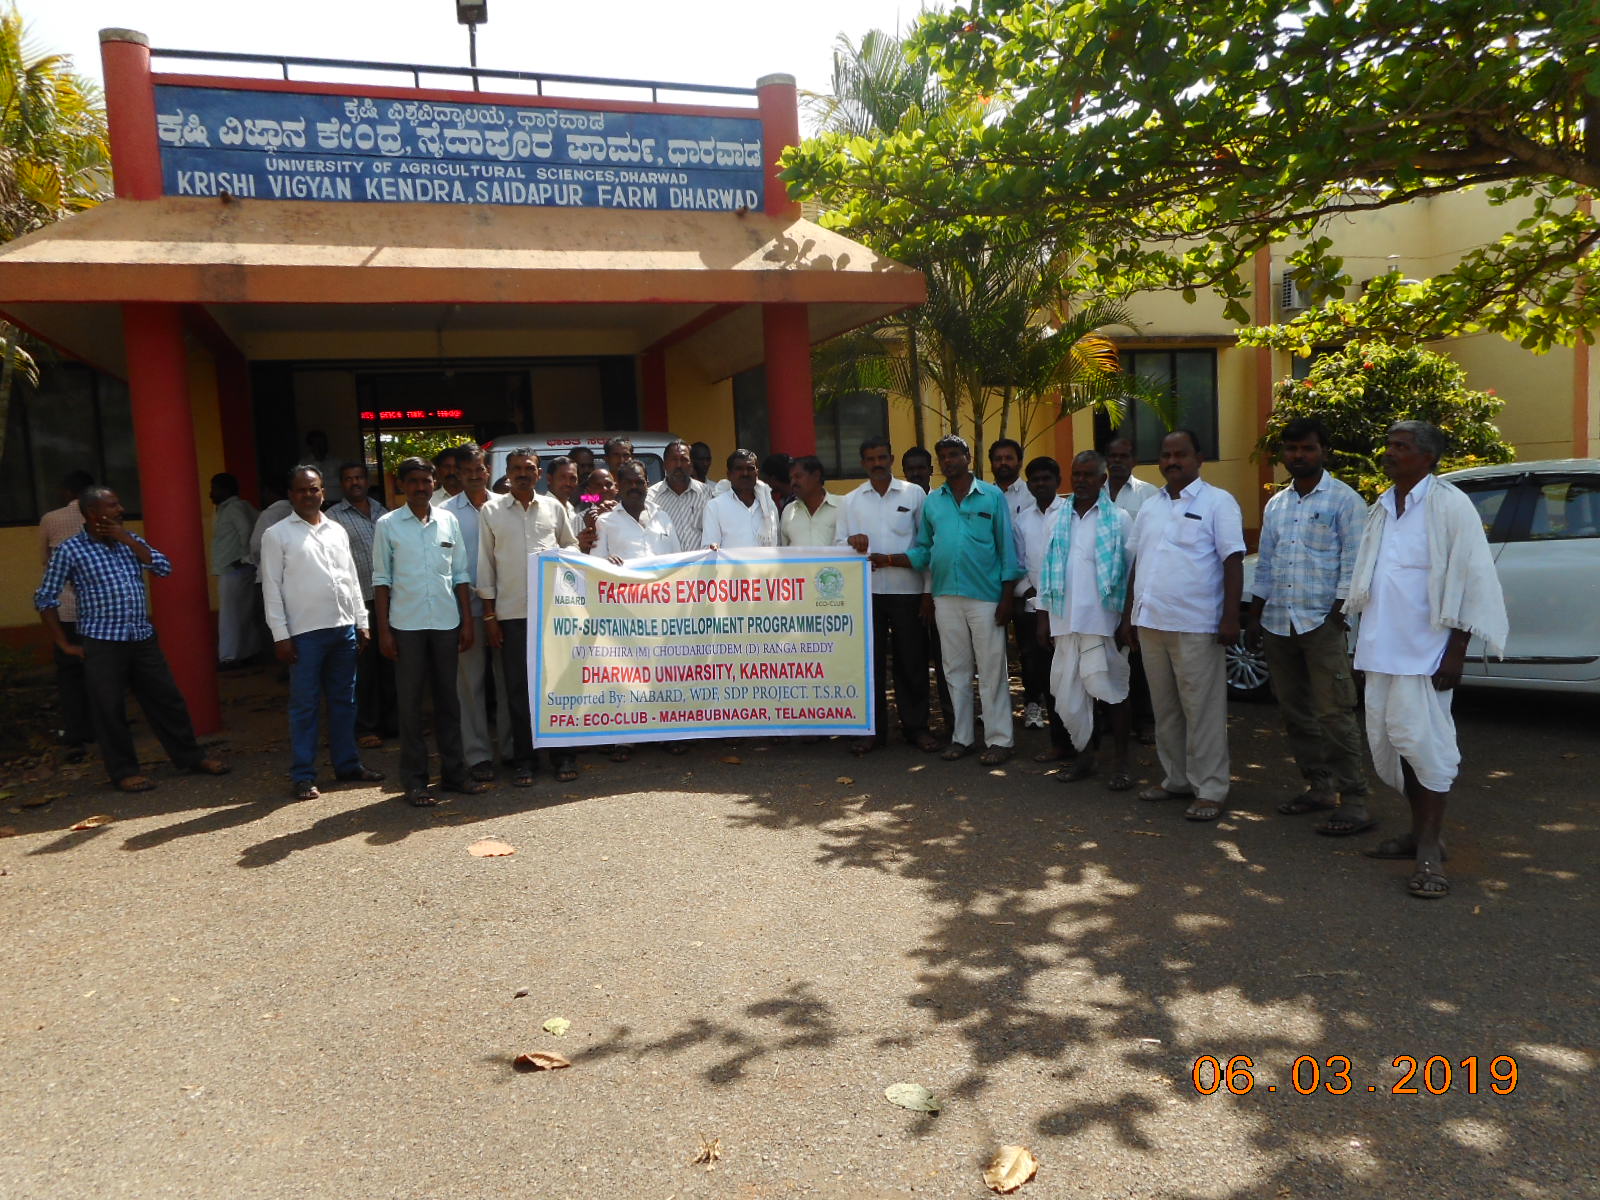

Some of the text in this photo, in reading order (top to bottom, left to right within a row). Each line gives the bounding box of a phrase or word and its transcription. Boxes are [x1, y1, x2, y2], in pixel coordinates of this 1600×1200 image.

[157, 108, 210, 147] ಕೃಷಿ
[218, 116, 306, 155] ವಿಜ್ಞಾನ
[265, 158, 363, 174] UNIVERSITY
[373, 161, 392, 174] OF
[399, 162, 526, 179] AGRICULTURAL
[177, 170, 256, 197] KRISHI
[268, 175, 350, 199] VIGYAN
[597, 184, 658, 208] FARM
[670, 189, 758, 210] DHARWAD
[555, 595, 586, 606] NABARD
[598, 577, 805, 604] FARMARS EXPOSURE VISIT
[554, 614, 854, 636] WDF-SUSTAINABLE DEVELOPMENT PROGRAMME(SDP)
[572, 642, 834, 659] (V) YEDHIRA (M) CHOUDARIGUDEM (D) RANGA REDDY
[582, 662, 825, 684] DHARWAD UNIVARSITY, KARNATAKA
[547, 691, 605, 710] Supported
[609, 691, 626, 709] By:
[630, 689, 686, 704] NABARD,
[690, 687, 720, 702] WDF,
[724, 687, 749, 700] SDP
[813, 684, 859, 699] T.S.R.O.
[550, 714, 579, 727] PFA:
[584, 711, 648, 726] ECO-CLUB
[659, 708, 771, 723] MAHABUBNAGAR,
[775, 706, 856, 720] TELANGANA.
